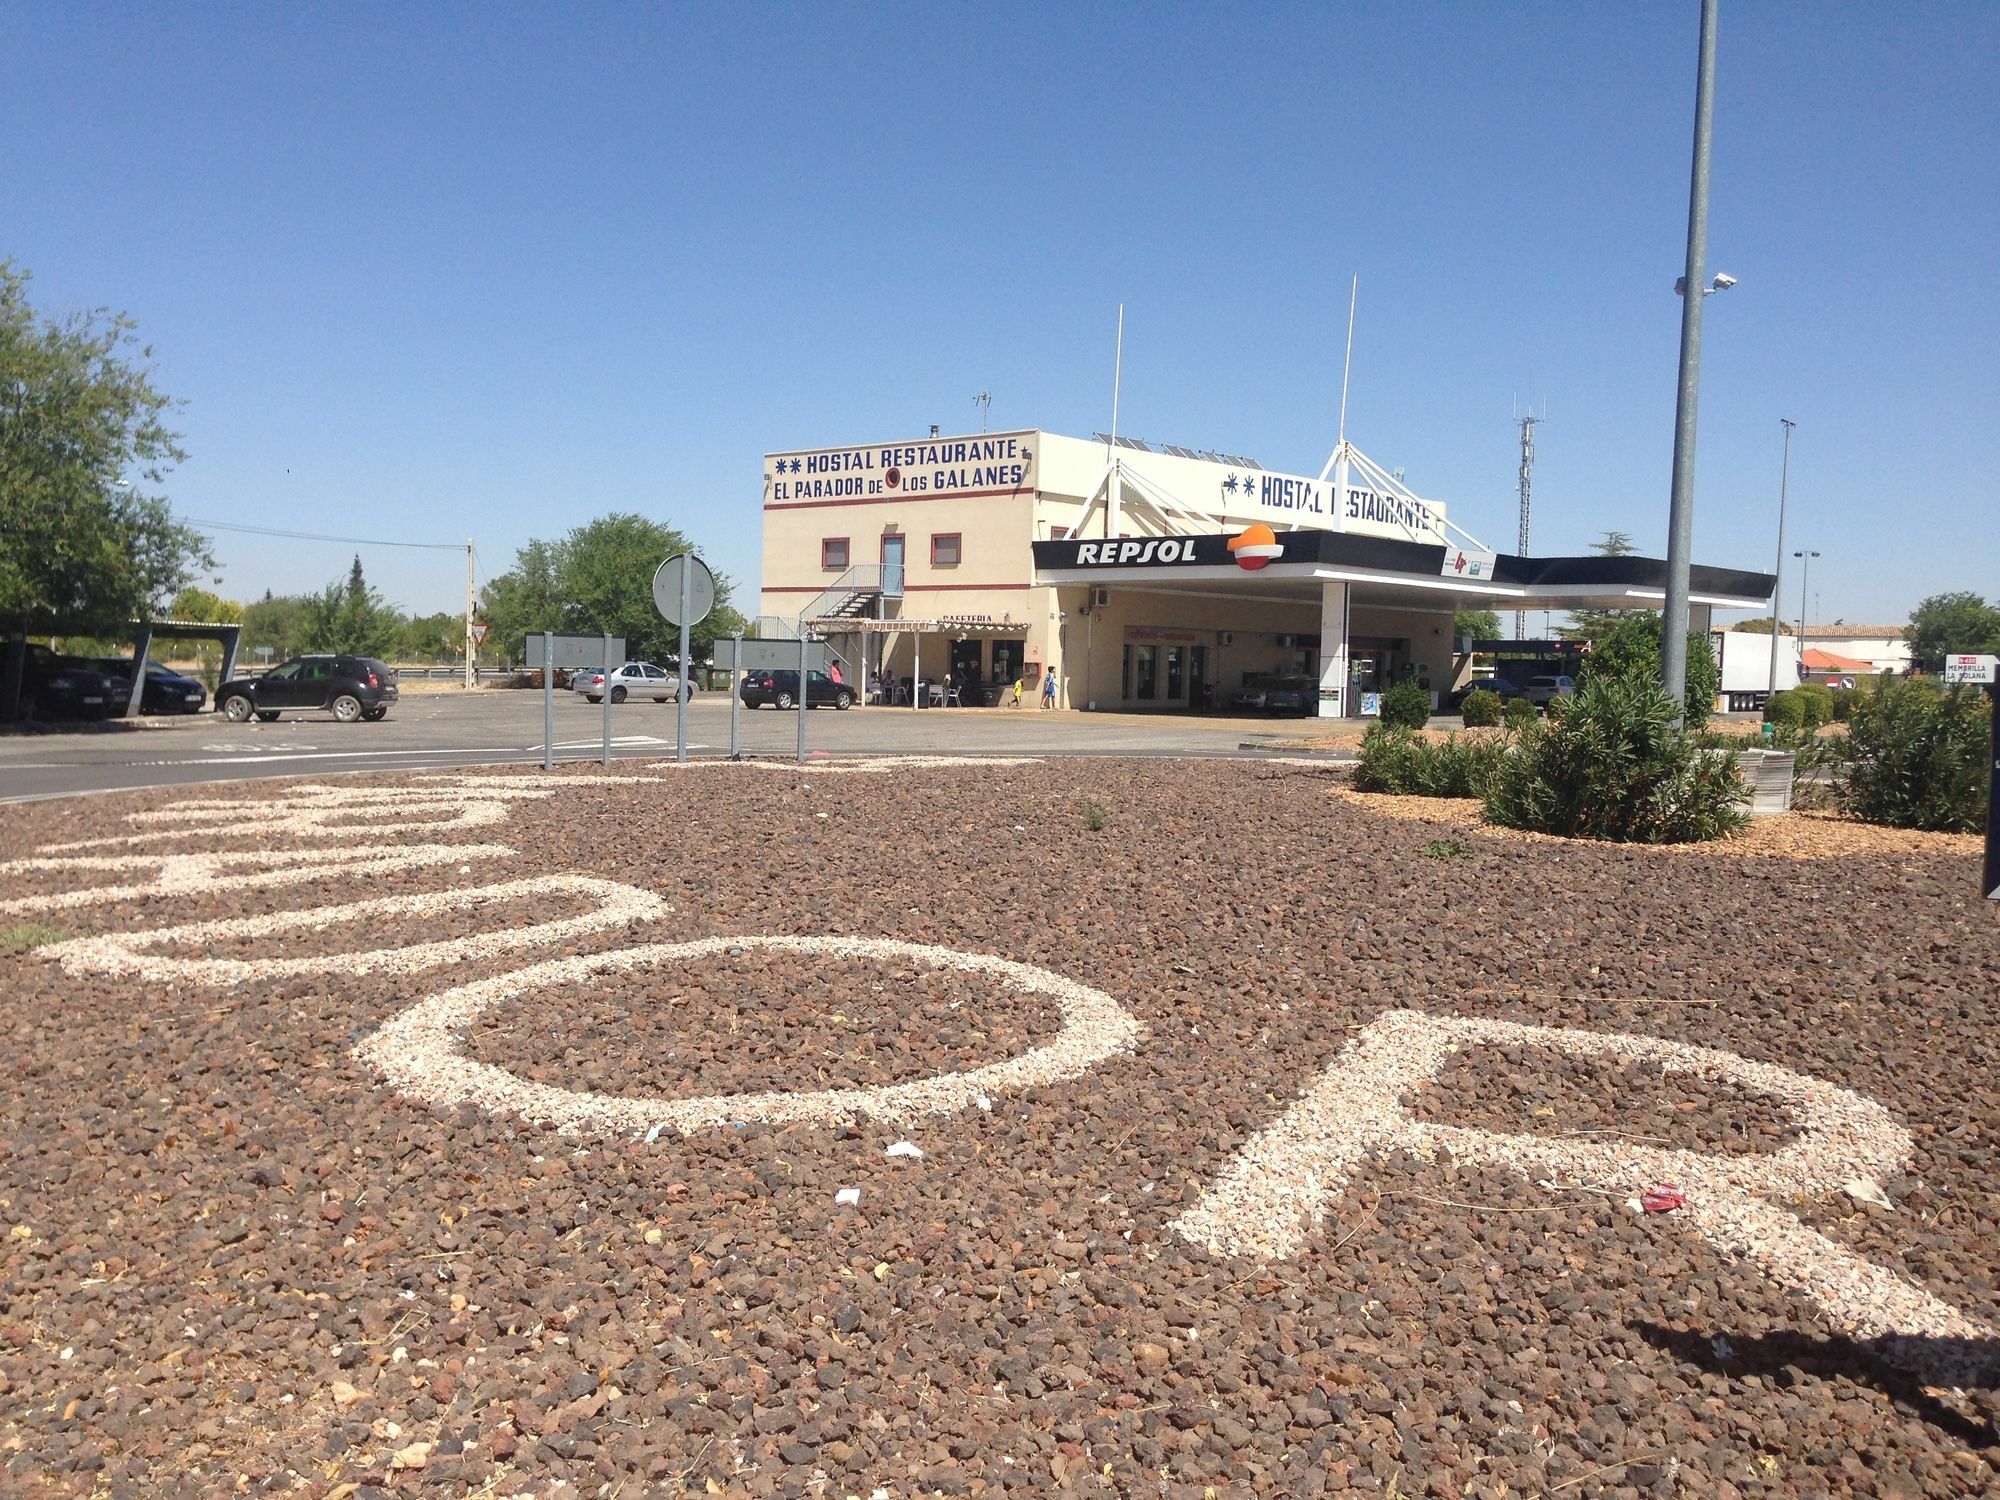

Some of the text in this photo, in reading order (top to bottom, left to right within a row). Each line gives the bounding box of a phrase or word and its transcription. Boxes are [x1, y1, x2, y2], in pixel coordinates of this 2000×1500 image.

[807, 439, 1017, 474] HOSTAL RESTAURANTE
[774, 464, 1023, 500] EL PARADOR DE LOS GALANES
[1261, 475, 1323, 513] HOSTAL
[1076, 540, 1197, 564] REPSOL
